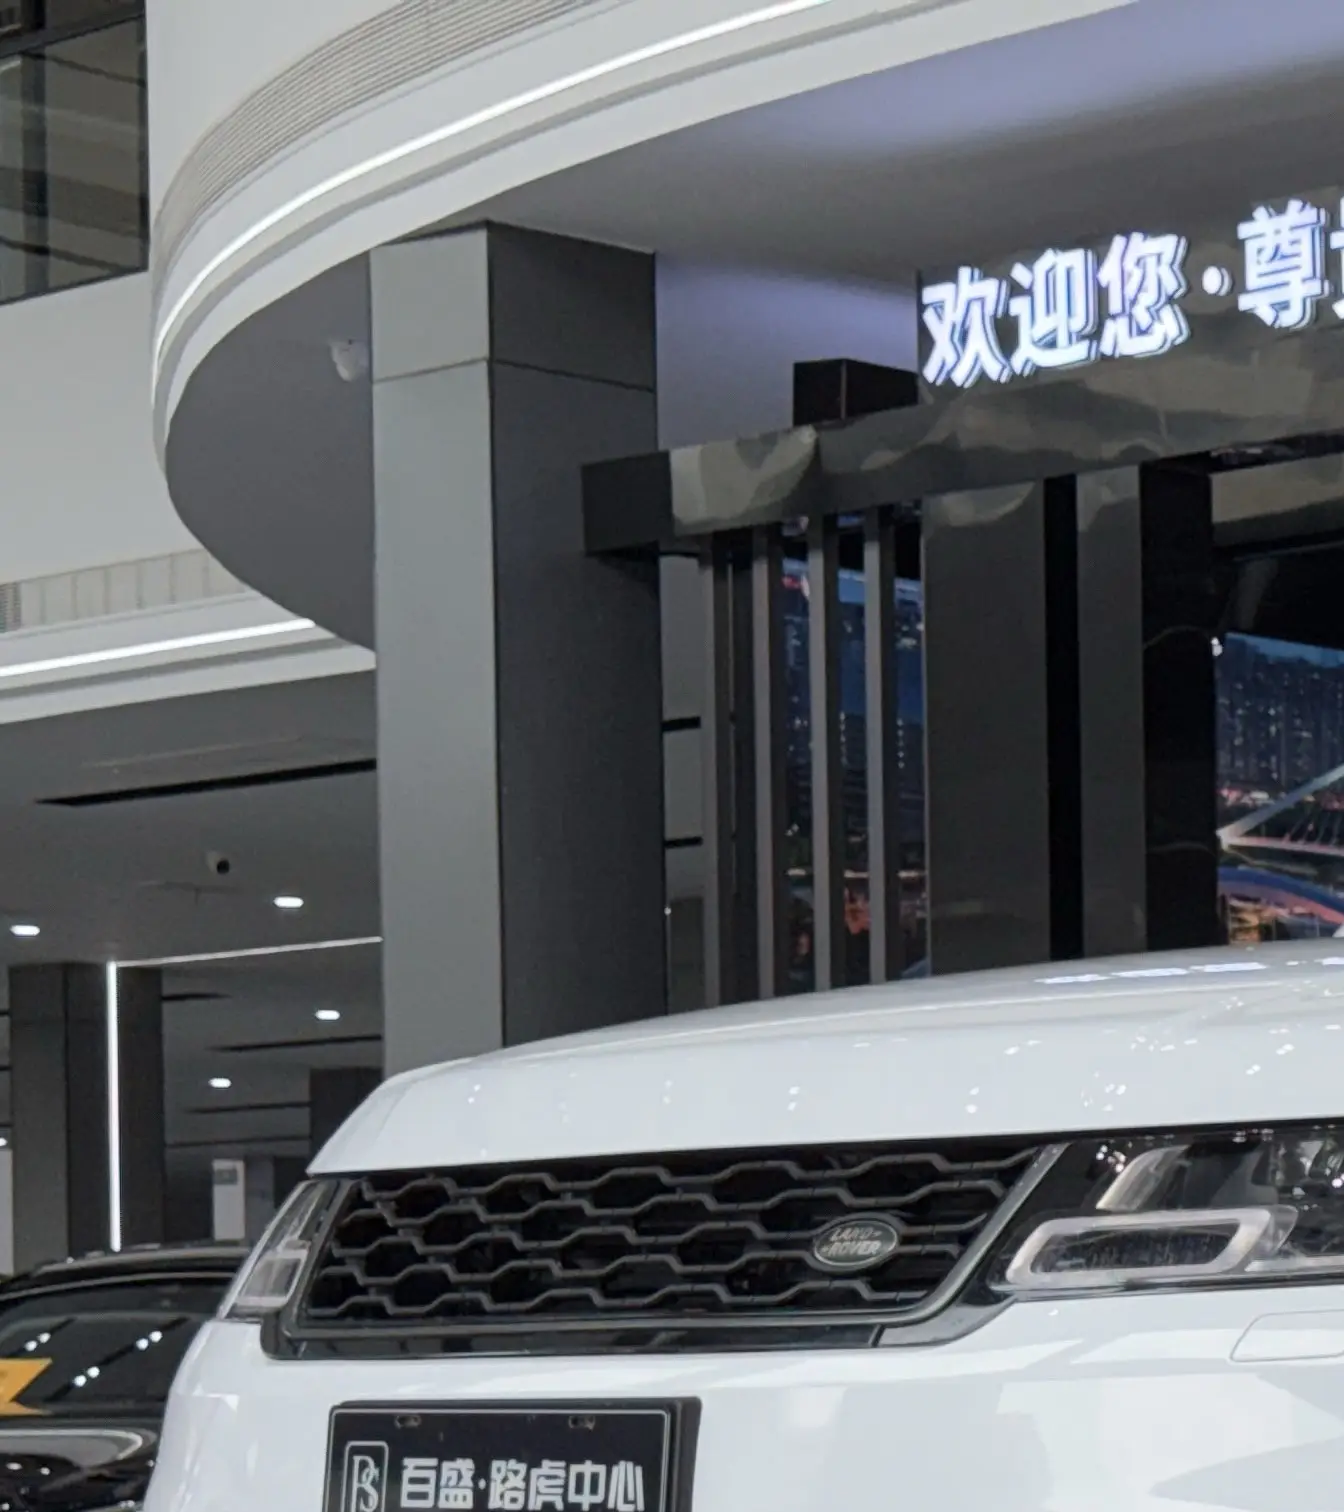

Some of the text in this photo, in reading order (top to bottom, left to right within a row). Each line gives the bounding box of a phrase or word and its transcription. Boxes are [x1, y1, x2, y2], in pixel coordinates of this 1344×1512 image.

[400, 1457, 645, 1512] 百盛·路虎中心
